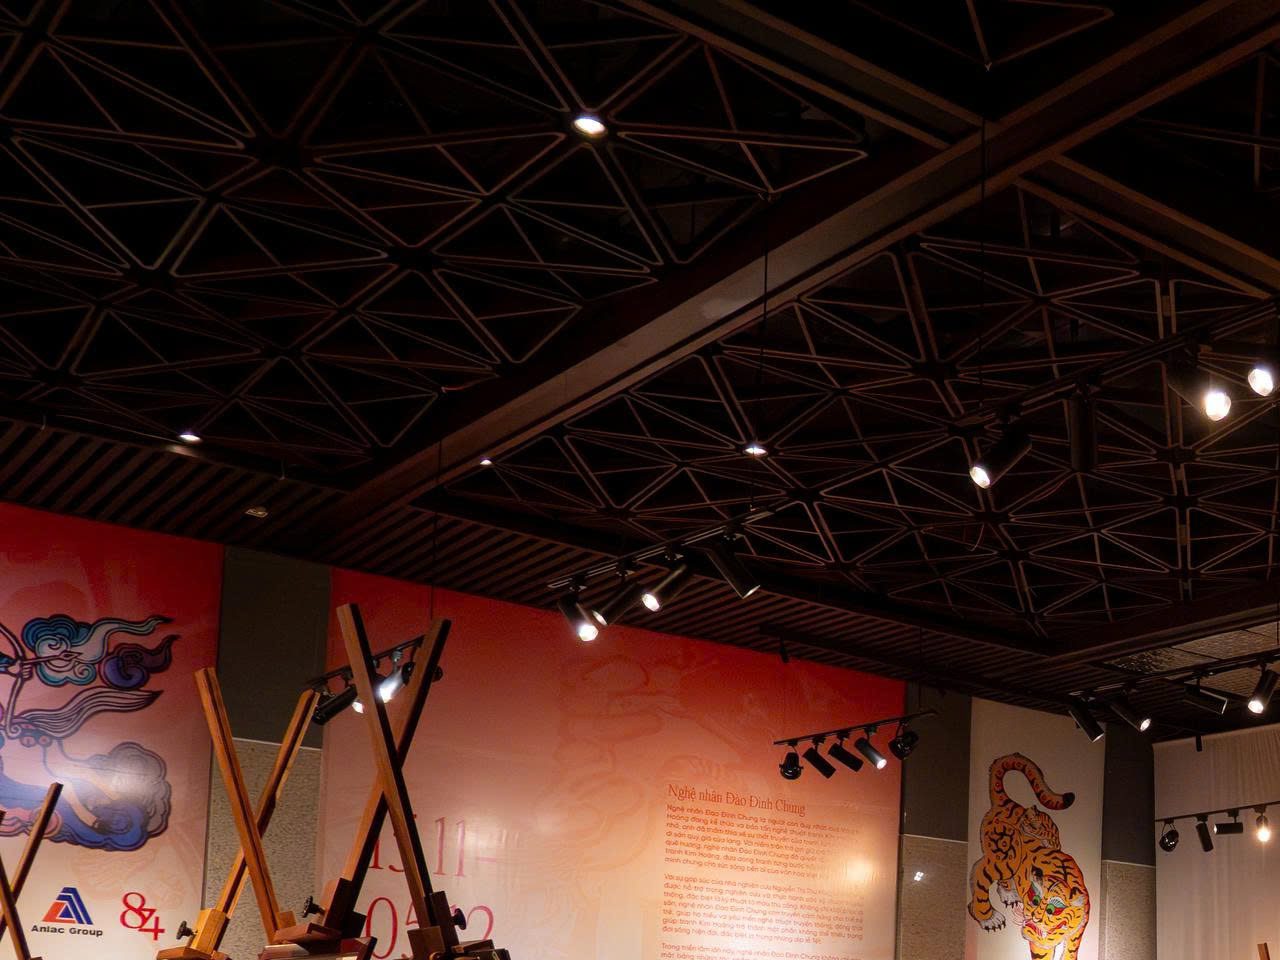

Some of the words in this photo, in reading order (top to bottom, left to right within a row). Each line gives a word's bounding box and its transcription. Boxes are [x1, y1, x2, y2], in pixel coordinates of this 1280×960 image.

[668, 783, 697, 803] Nghệ
[698, 789, 723, 804] nhân
[725, 792, 747, 807] Đào
[775, 799, 806, 818] Chung
[31, 925, 65, 935] Anlac
[69, 927, 104, 938] Group
[119, 892, 165, 941] 84
